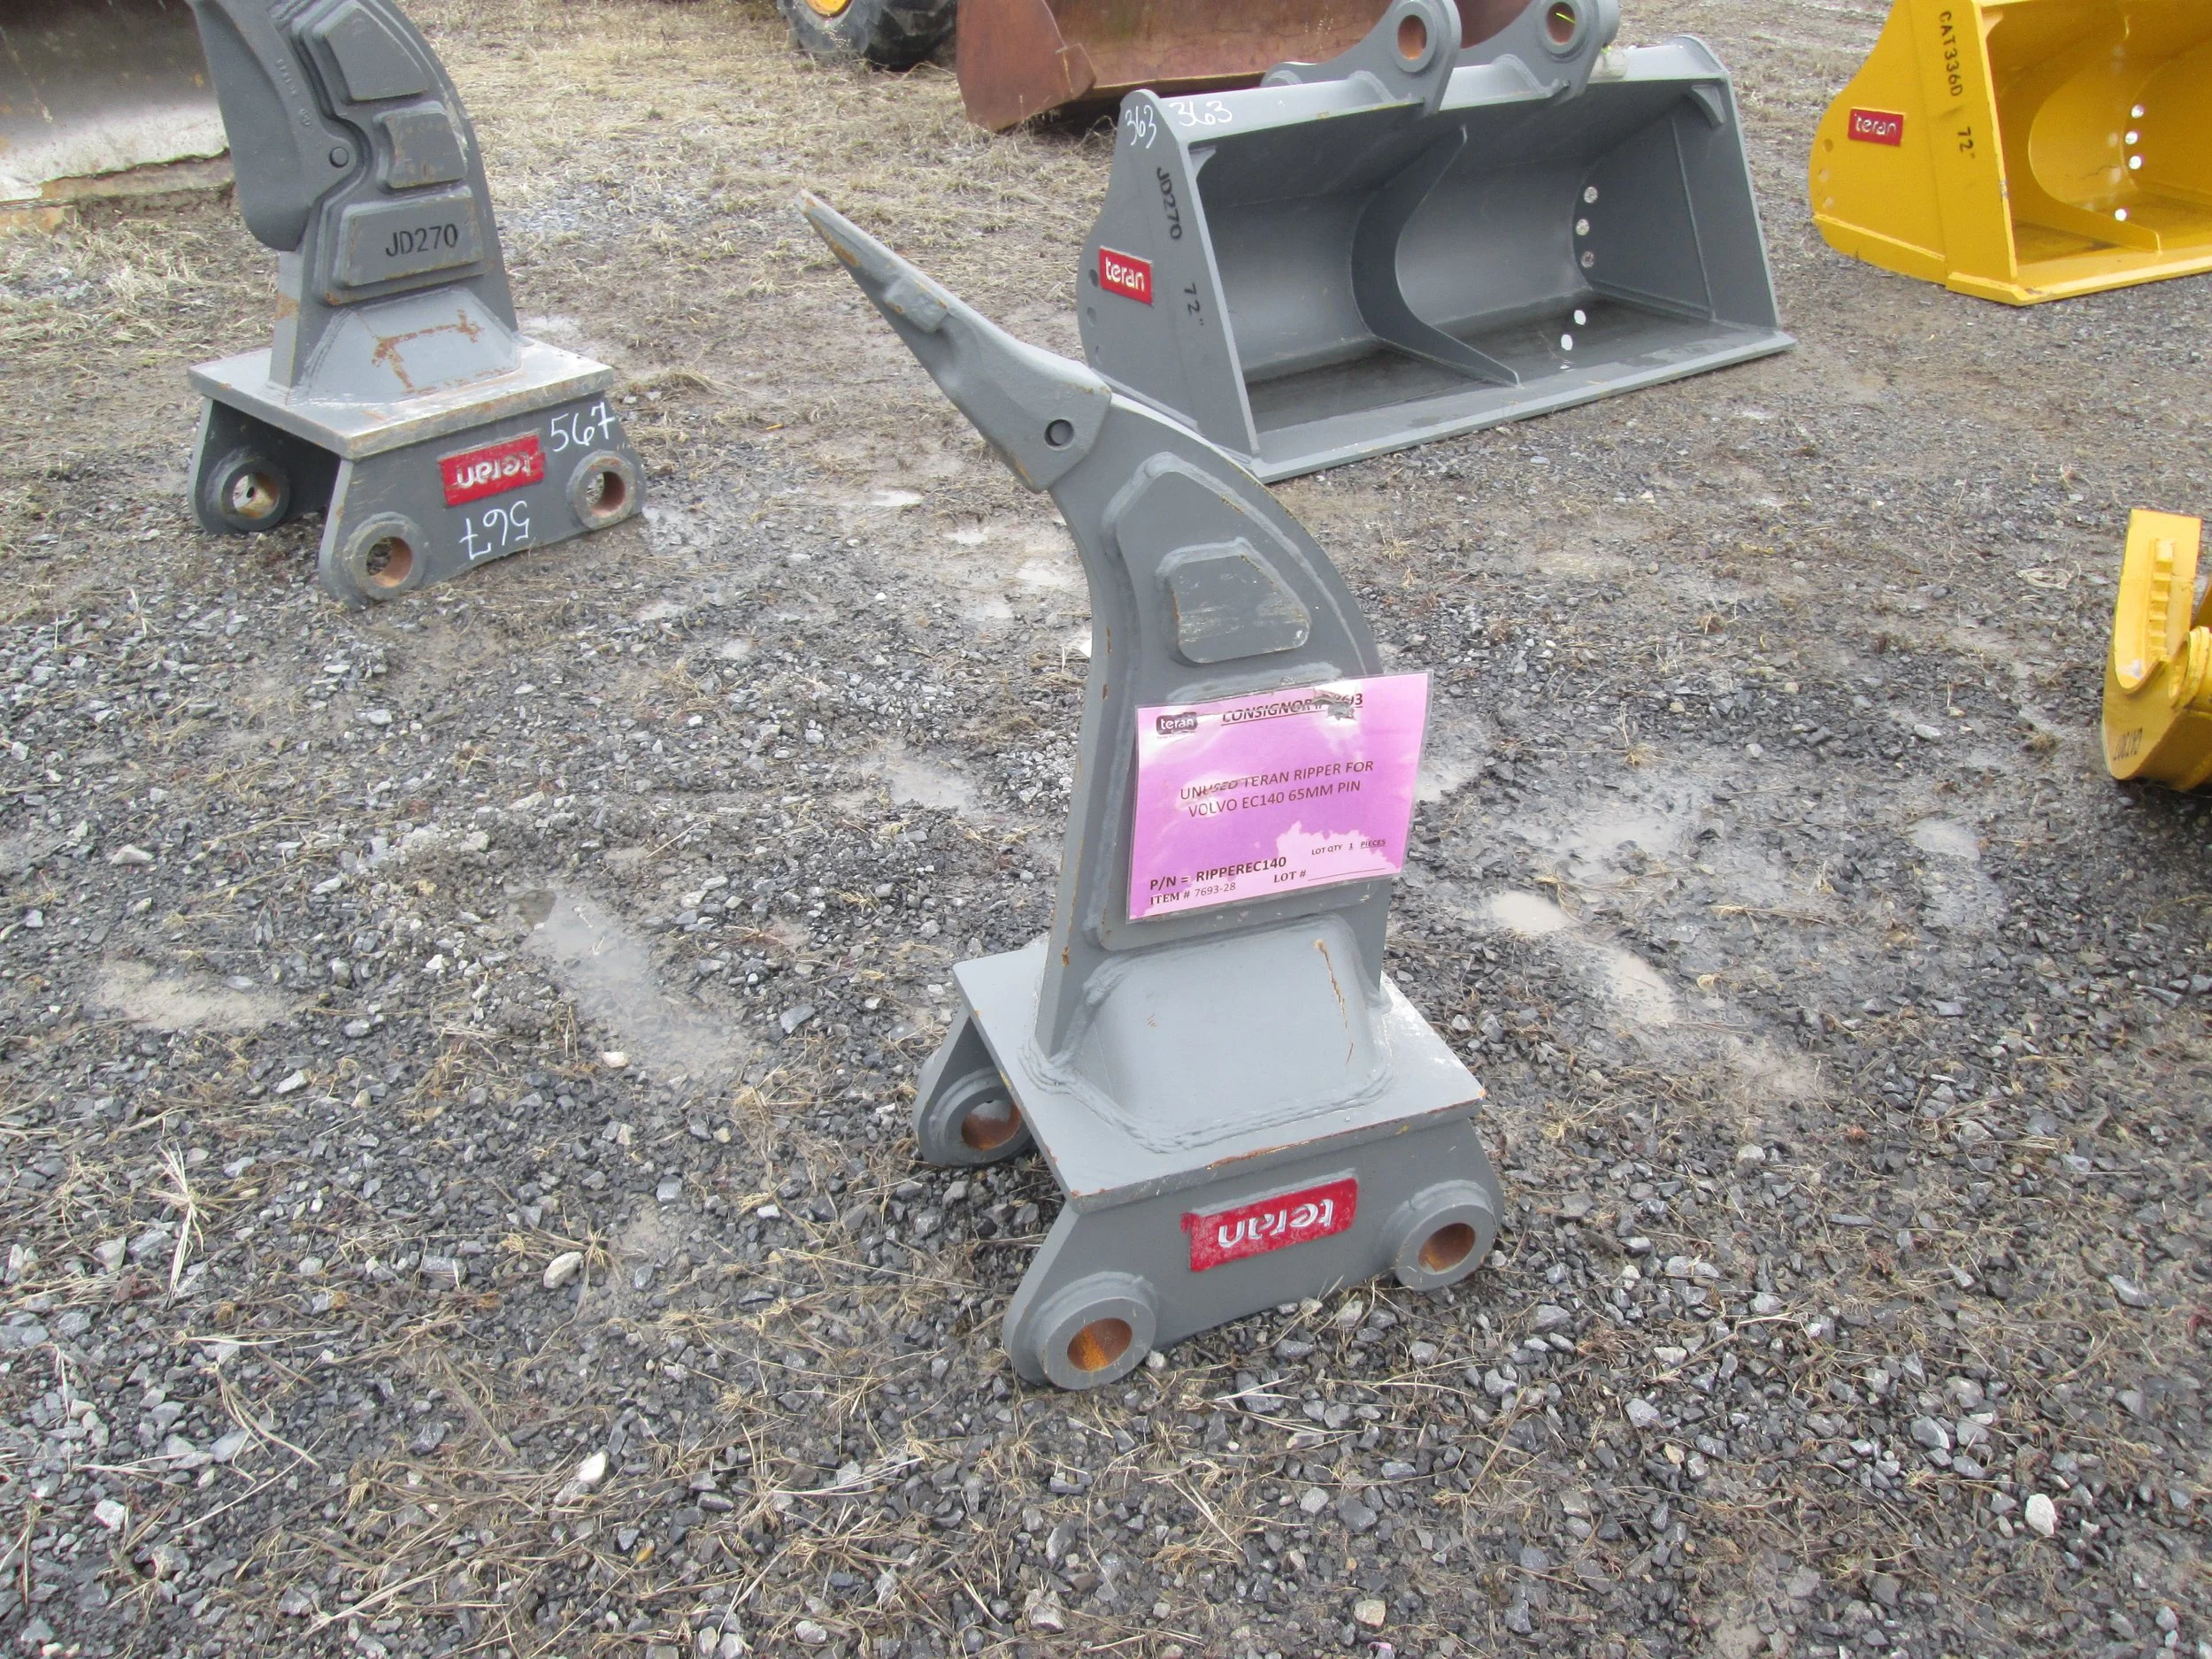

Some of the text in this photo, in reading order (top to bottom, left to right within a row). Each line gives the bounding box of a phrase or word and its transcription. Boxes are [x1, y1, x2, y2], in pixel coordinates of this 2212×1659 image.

[1939, 11, 1963, 96] CAT336D
[1125, 104, 1156, 149] 363
[1169, 100, 1233, 127] 363
[1855, 114, 1897, 136] teran
[1156, 166, 1183, 240] JD270
[386, 223, 458, 257] JD270
[1105, 257, 1145, 291] teran
[550, 401, 616, 452] 567
[456, 450, 533, 488] teran
[459, 501, 530, 560] 567
[1161, 718, 1194, 730] teran
[1222, 698, 1313, 723] CONSIGNOR
[1180, 760, 1374, 800] UNUSED TERAN RIPPER FOR
[1188, 780, 1361, 818] VOLVO EC140 65MM PIN
[1311, 846, 1326, 856] LOT
[1327, 844, 1342, 854] QTY
[1360, 839, 1386, 849] PIECES
[1150, 875, 1177, 892] P/N
[1196, 856, 1287, 882] RIPPEREC140
[1273, 871, 1296, 883] LOT
[1150, 882, 1236, 906] ITEM # 7693-28
[1218, 1199, 1333, 1248] teran
